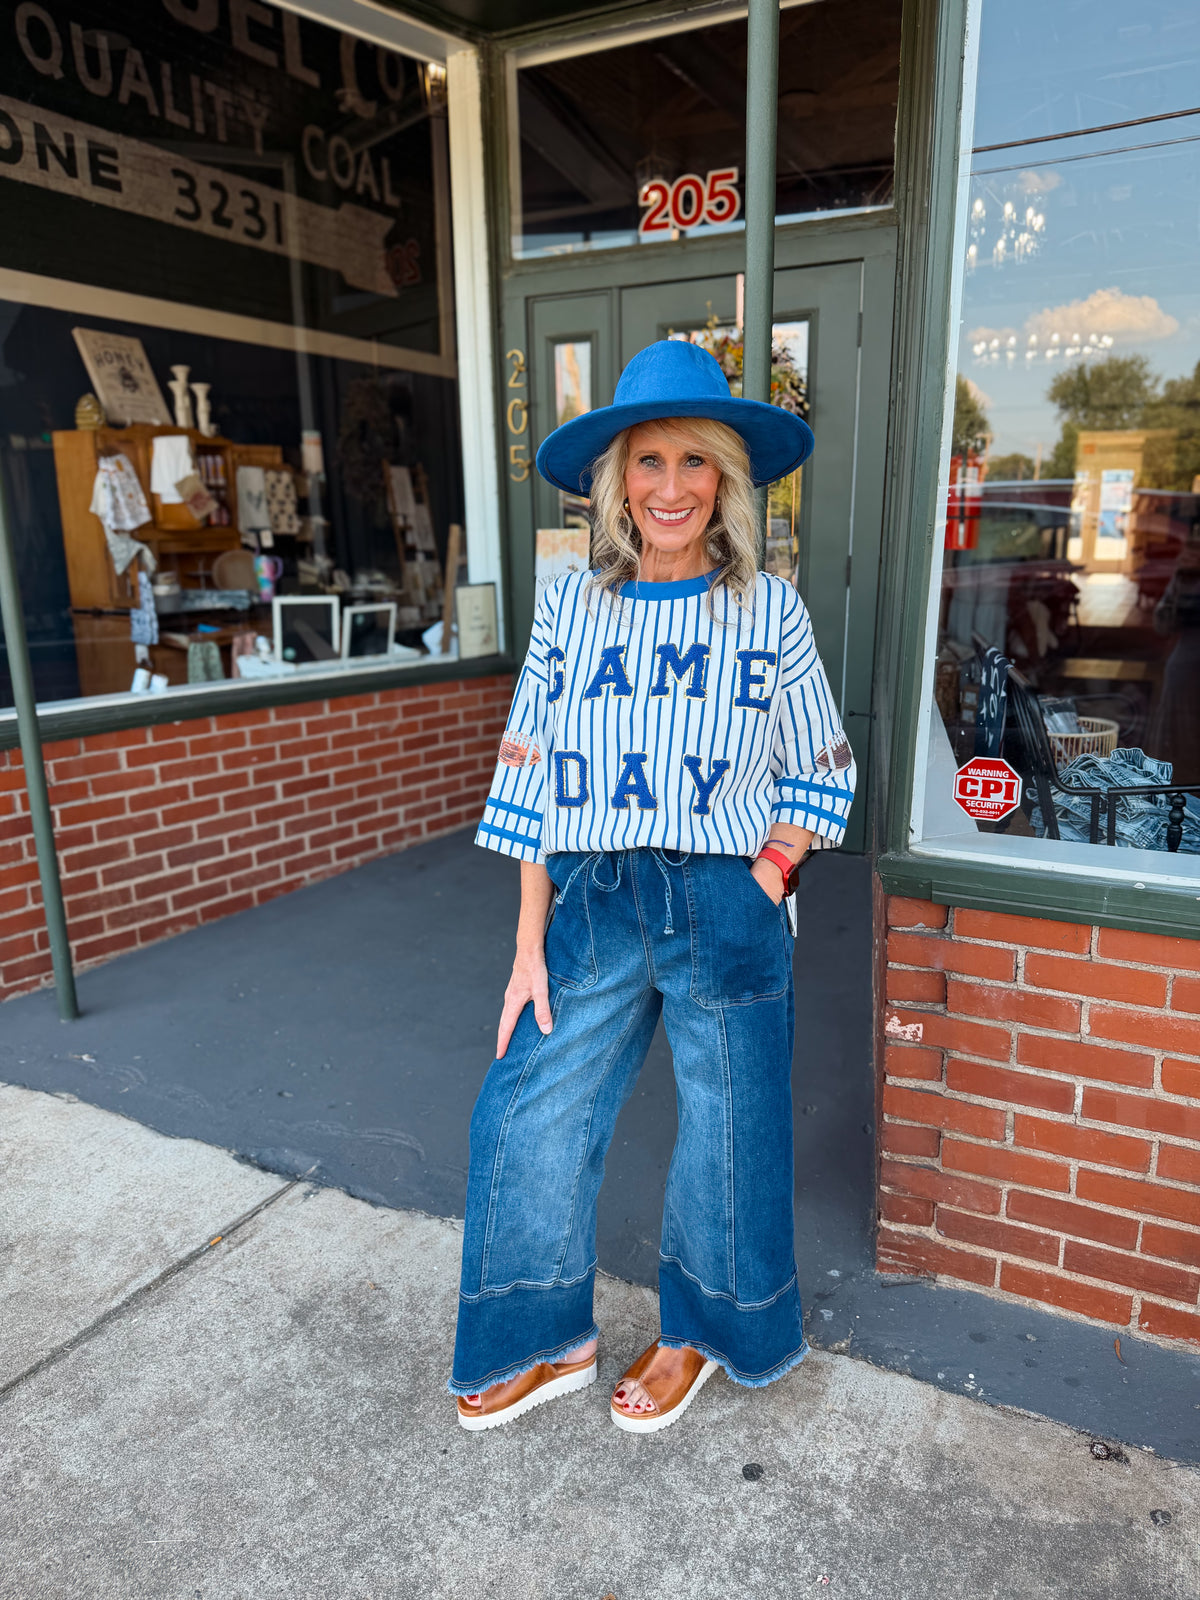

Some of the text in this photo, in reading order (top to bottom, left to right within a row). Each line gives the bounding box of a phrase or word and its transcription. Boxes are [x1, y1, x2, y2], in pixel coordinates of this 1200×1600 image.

[15, 1, 401, 208] QUALITY COAL
[171, 168, 283, 245] 3231
[638, 166, 741, 235] 205
[506, 349, 531, 482] 205
[545, 642, 778, 714] GAME
[554, 749, 731, 816] DAY
[958, 777, 1015, 801] CPI
[966, 800, 1005, 810] SECURITY
[968, 768, 1009, 778] WARNING
